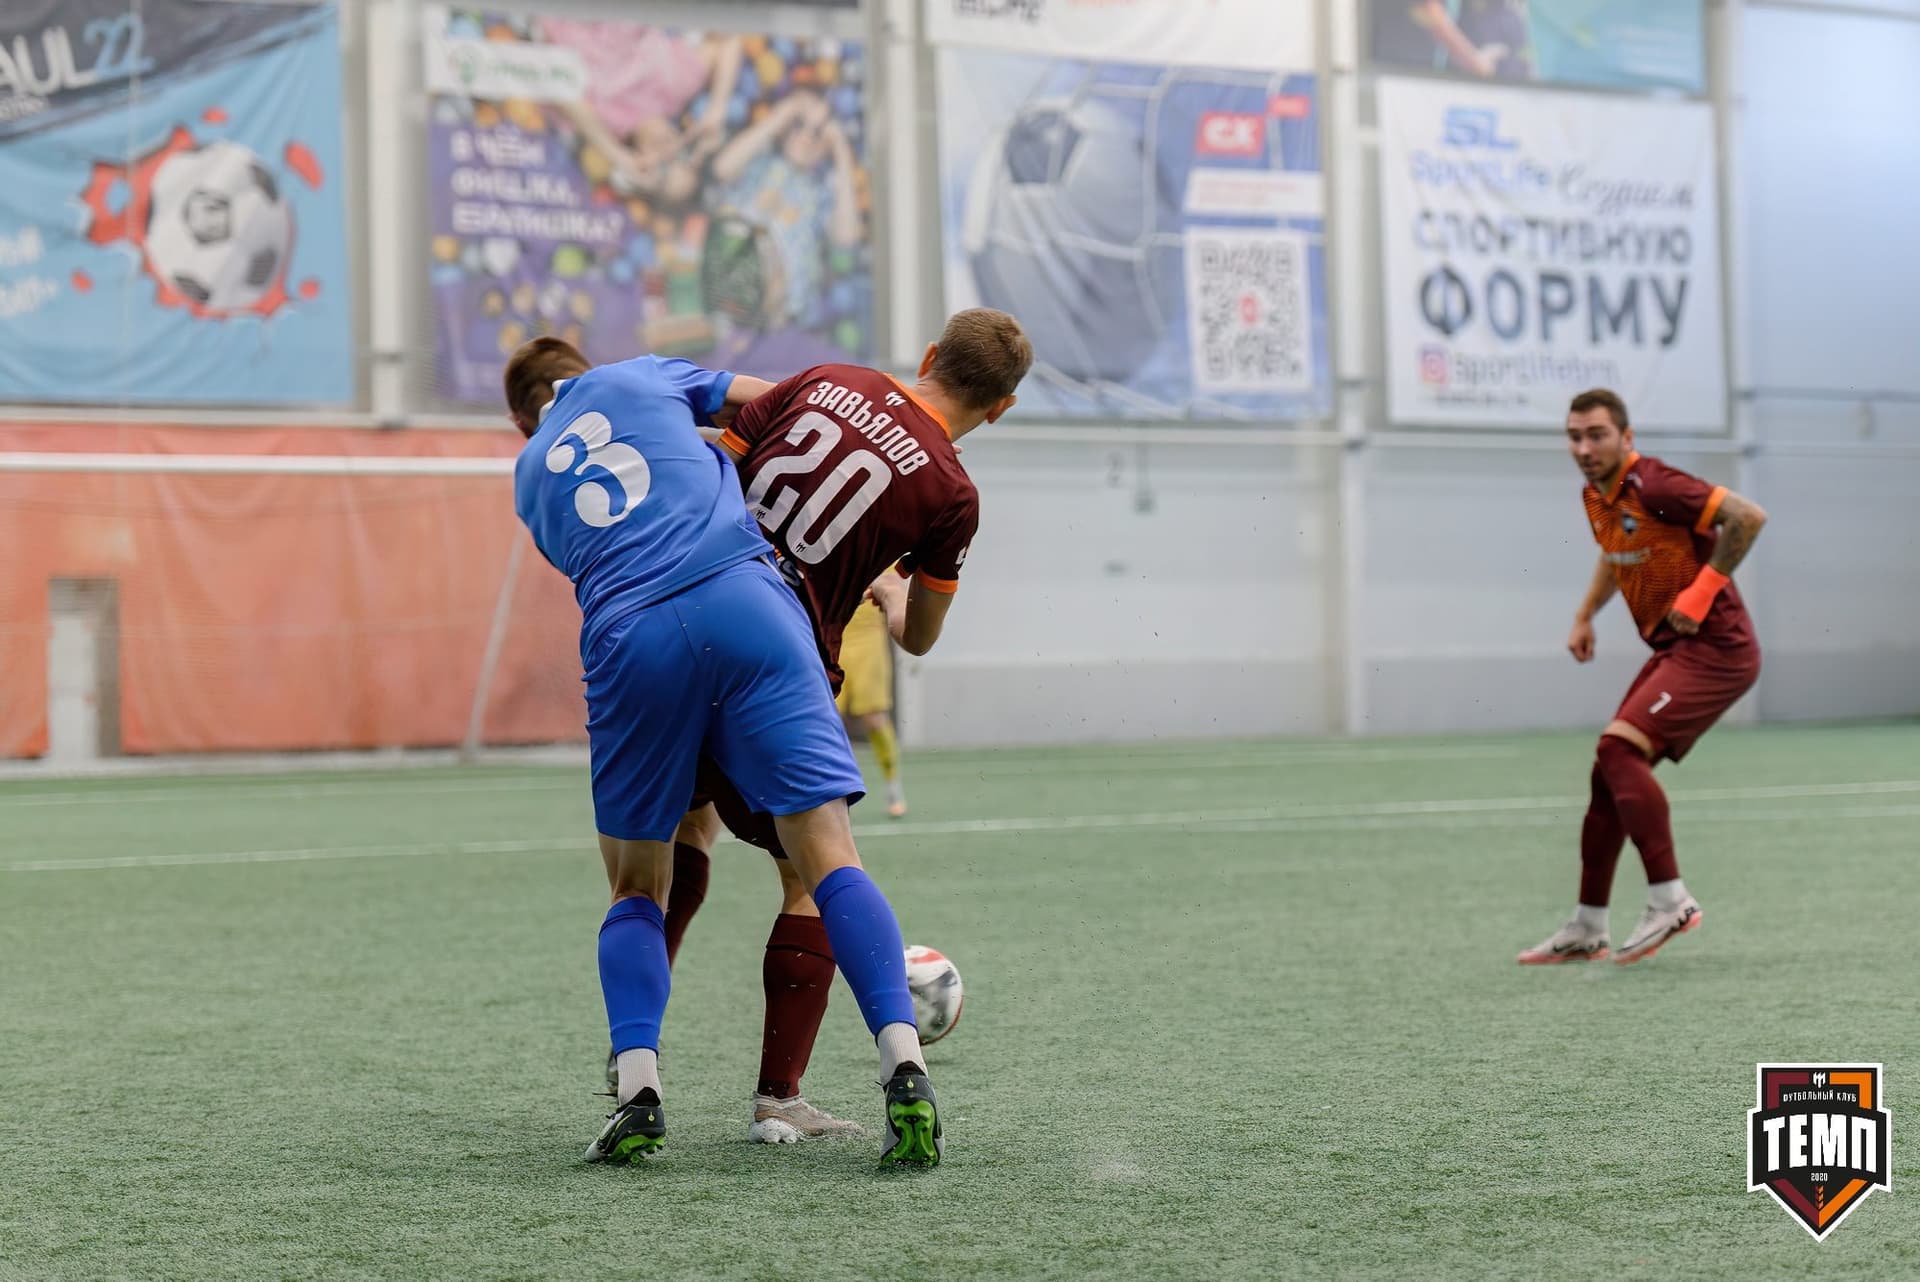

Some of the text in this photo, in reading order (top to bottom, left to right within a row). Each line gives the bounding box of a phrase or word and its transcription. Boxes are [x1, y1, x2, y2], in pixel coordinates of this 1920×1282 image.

[1412, 208, 1692, 264] СПОРТИВНУЮ
[1419, 265, 1689, 347] ФОРМУ
[545, 411, 651, 528] 3
[806, 381, 930, 476] ЗАВЬЯЛОВ
[745, 411, 893, 565] 20
